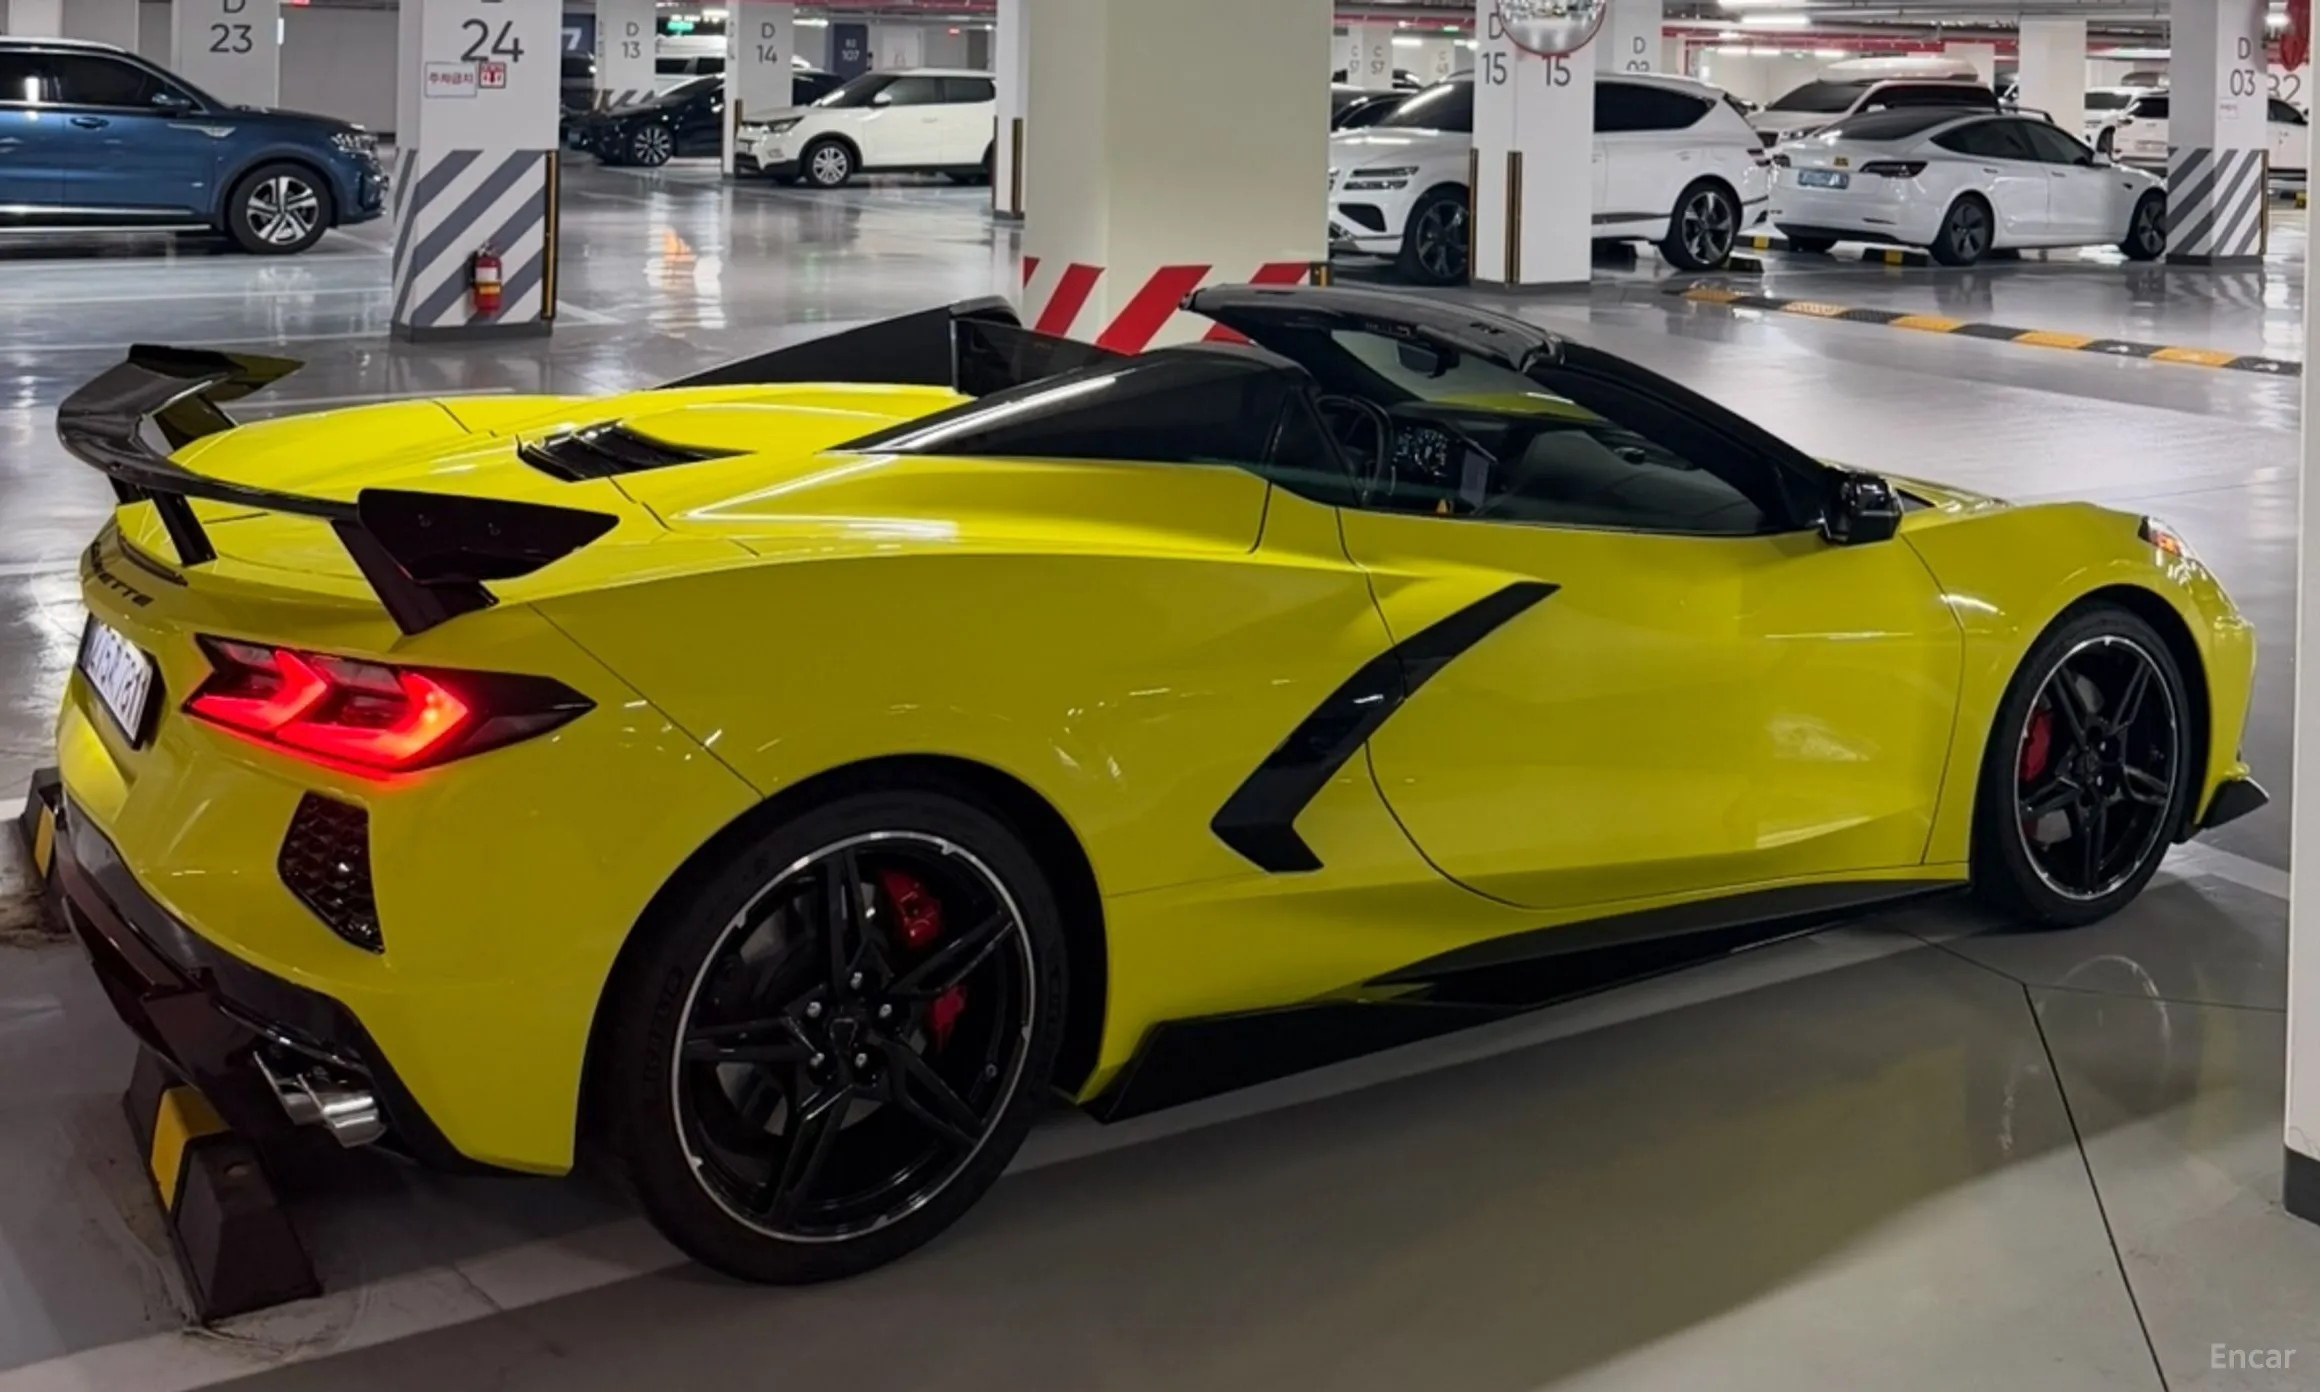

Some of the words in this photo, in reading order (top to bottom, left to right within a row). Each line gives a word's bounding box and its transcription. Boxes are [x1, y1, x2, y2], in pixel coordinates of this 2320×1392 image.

[626, 22, 640, 37] D
[761, 22, 775, 39] D
[1489, 12, 1503, 40] D
[209, 23, 253, 54] 23
[460, 18, 524, 63] 24
[622, 41, 641, 59] 13
[1633, 36, 1646, 54] D
[2237, 36, 2251, 60] D
[757, 44, 778, 64] 14
[428, 71, 474, 85] 주차금지
[1482, 53, 1507, 85] 15
[1541, 53, 1571, 87] 15
[2230, 69, 2256, 97] 03
